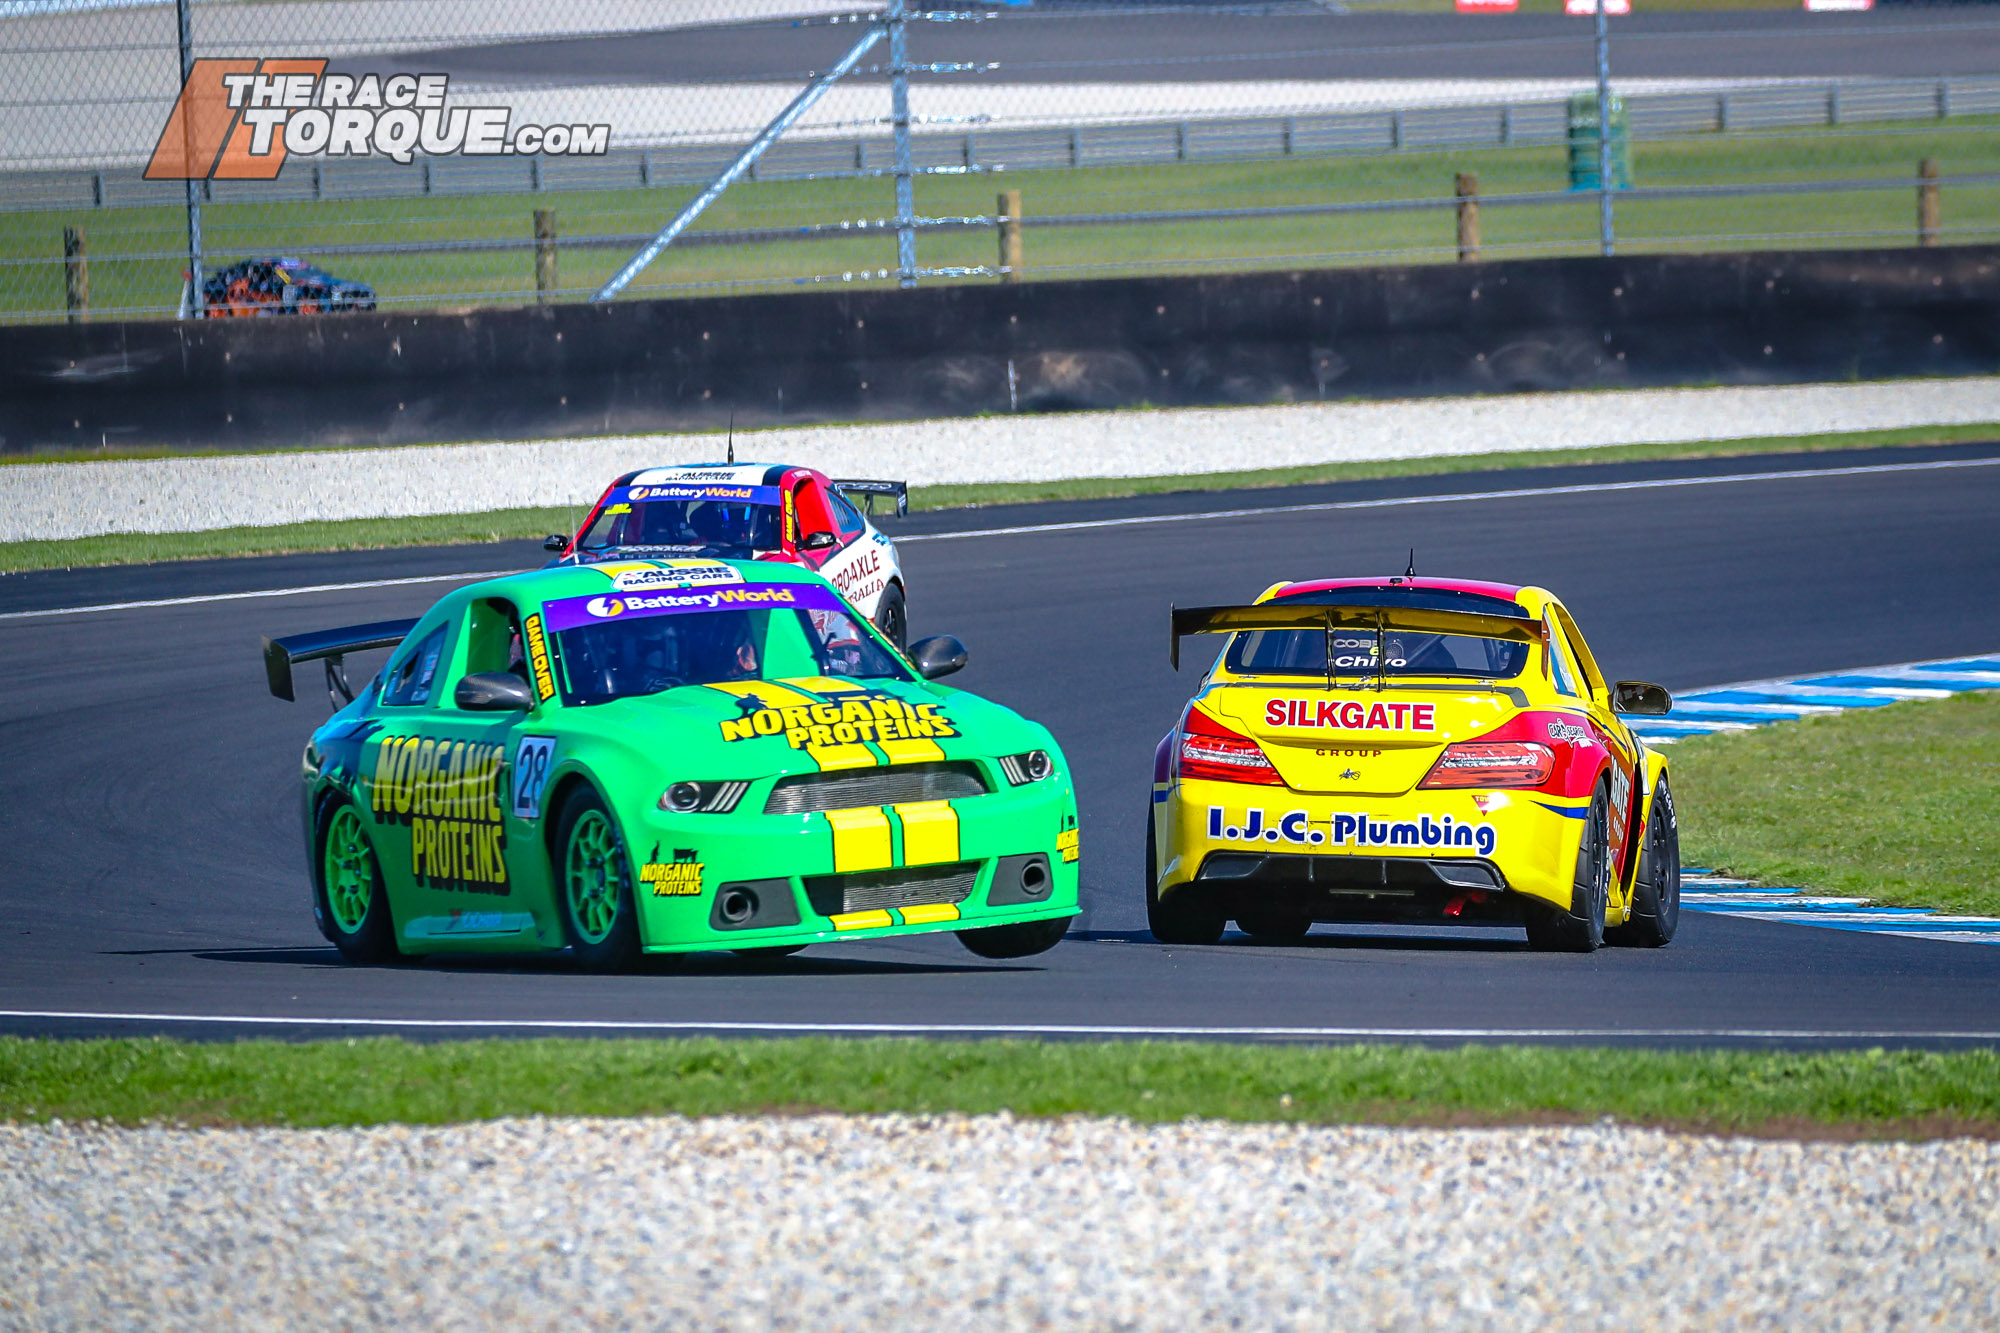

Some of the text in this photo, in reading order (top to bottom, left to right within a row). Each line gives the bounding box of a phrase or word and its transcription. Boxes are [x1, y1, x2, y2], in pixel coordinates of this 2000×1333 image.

[623, 573, 734, 586] RACING CARS
[642, 567, 731, 578] AUSSIE
[525, 615, 555, 700] GAME OVER
[719, 698, 946, 743] NORGANIC
[1265, 699, 1435, 731] SILKGATE
[785, 718, 956, 749] PROTEINS
[1315, 748, 1382, 758] GROUP
[373, 736, 505, 823] NORGANIC
[517, 743, 549, 809] 28
[1209, 807, 1496, 855] I.J.C. Plumbing
[412, 816, 506, 884] PROTEINS
[640, 863, 705, 882] NORGANIC
[653, 880, 702, 895] PROTEINS
